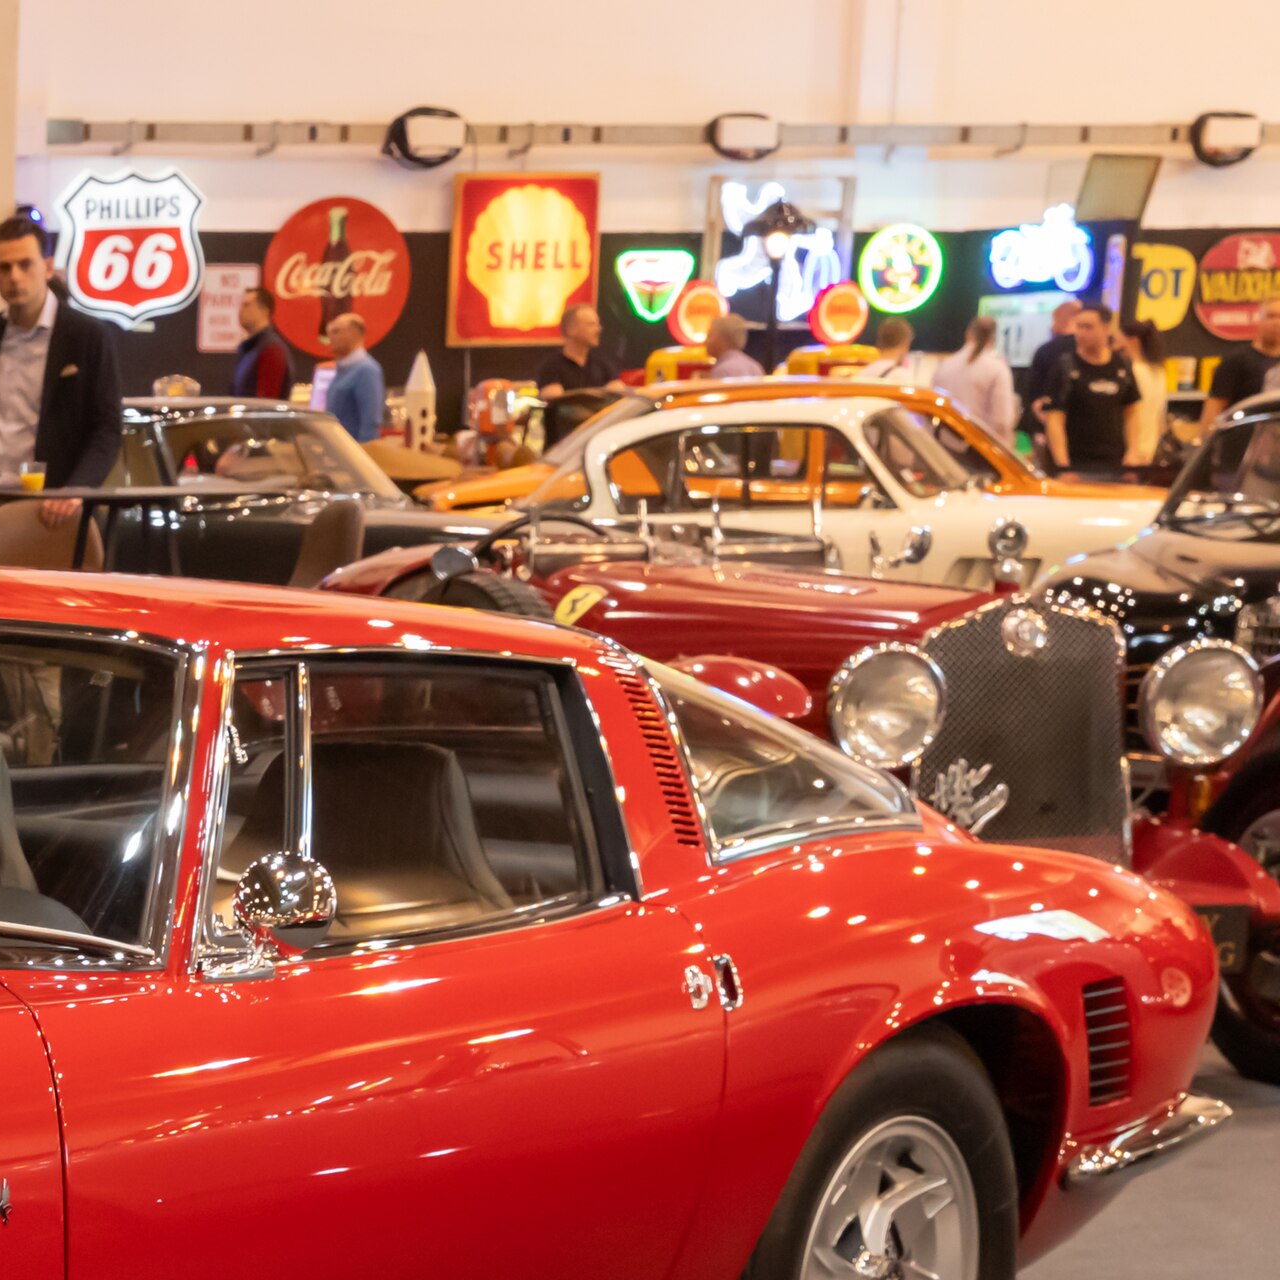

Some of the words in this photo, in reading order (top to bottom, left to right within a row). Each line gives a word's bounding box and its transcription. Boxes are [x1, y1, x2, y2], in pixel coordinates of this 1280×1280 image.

[85, 195, 181, 219] PHILLIPS
[88, 232, 177, 292] 66
[275, 250, 397, 299] Coca-Cola
[486, 240, 583, 271] SHELL
